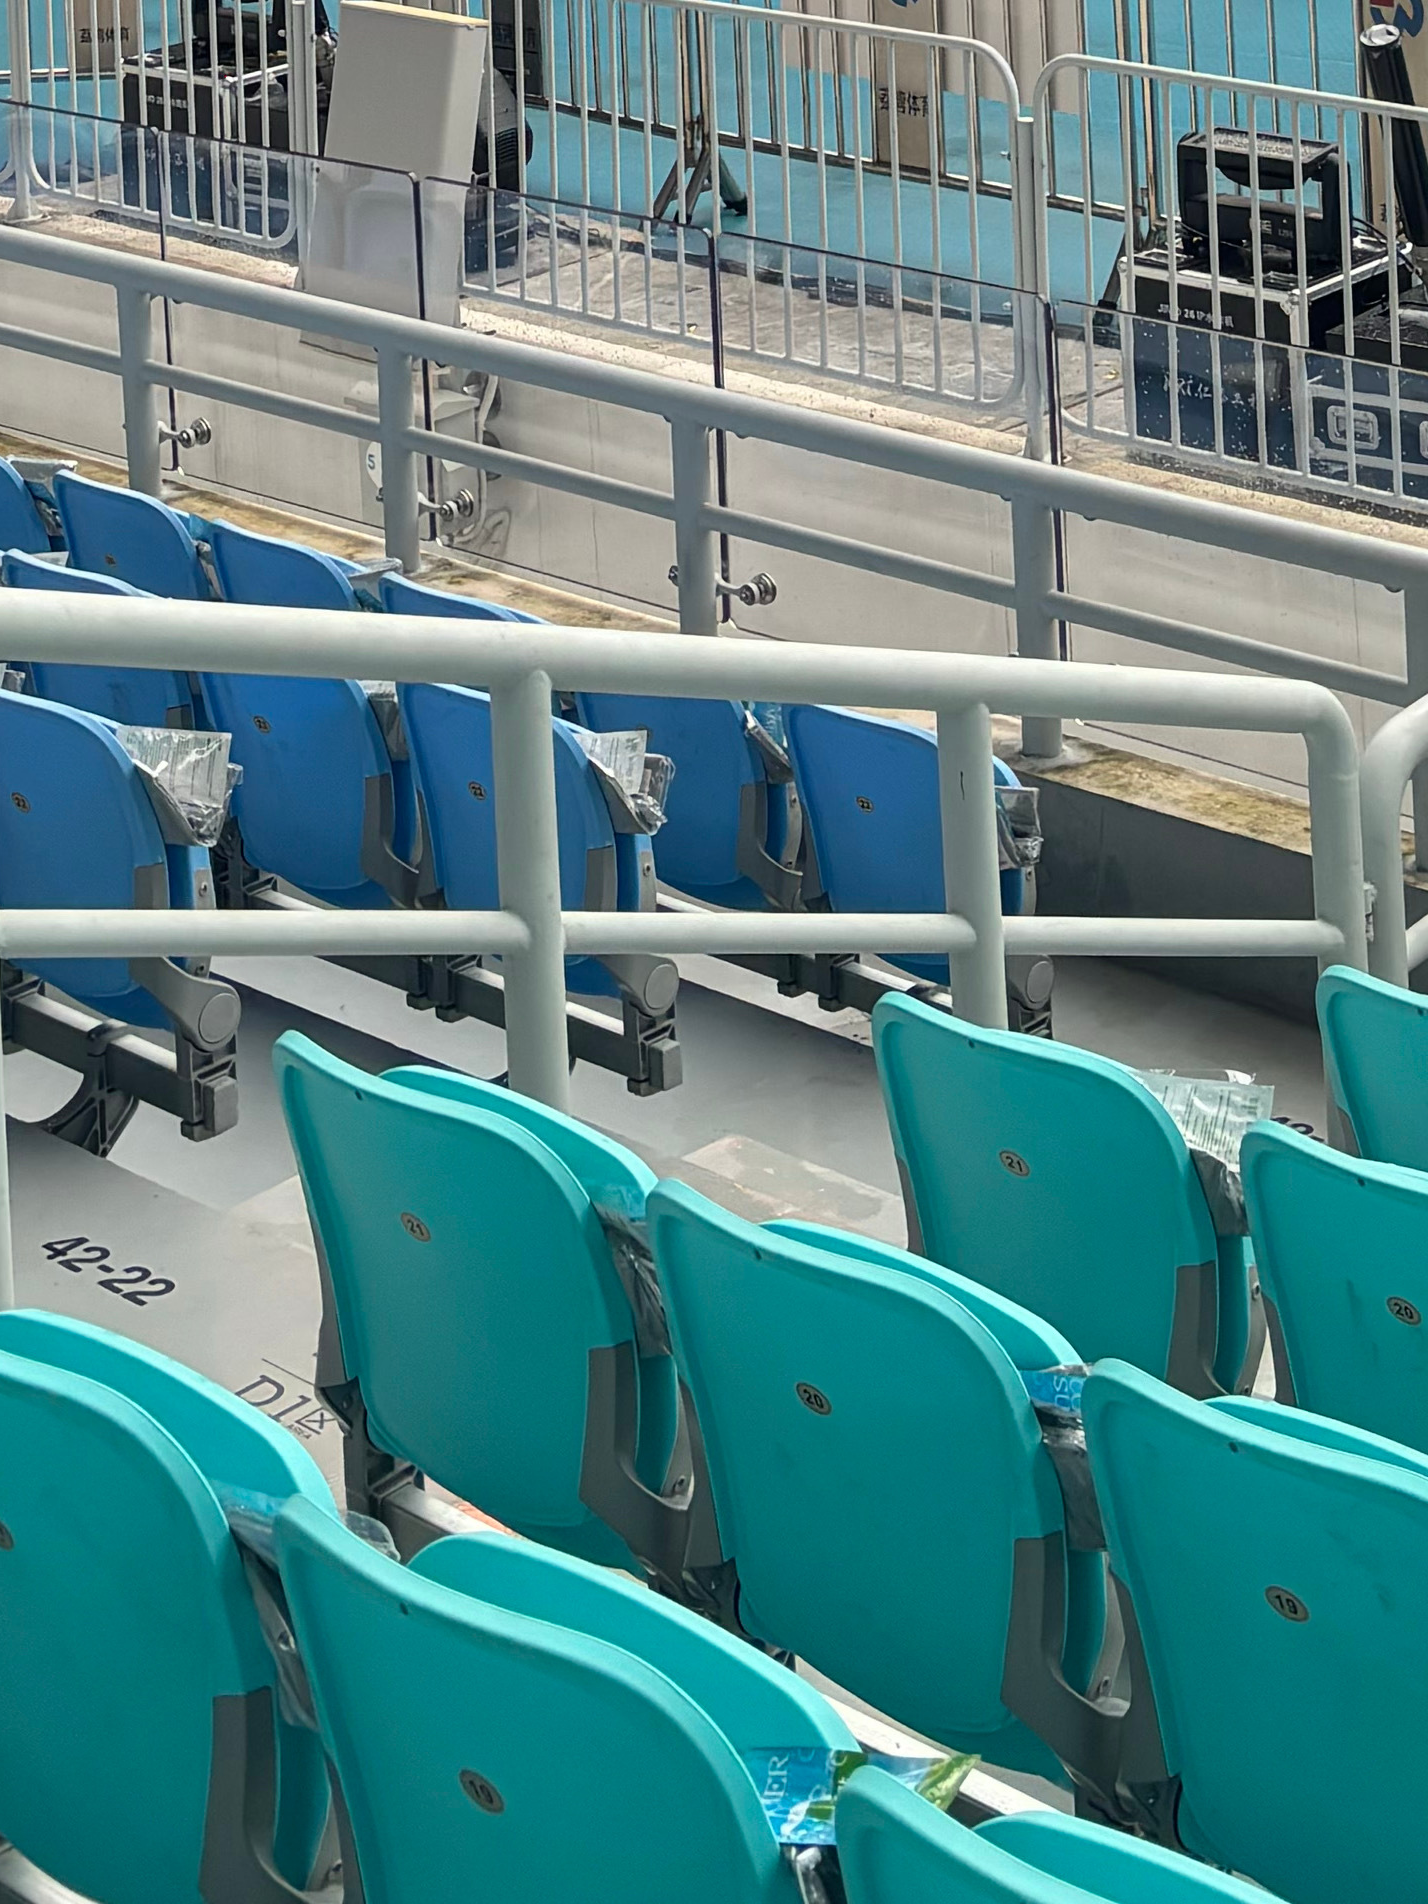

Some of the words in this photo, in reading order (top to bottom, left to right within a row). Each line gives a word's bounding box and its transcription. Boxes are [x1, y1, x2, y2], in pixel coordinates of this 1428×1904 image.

[1005, 1154, 1023, 1173] 21
[406, 1217, 424, 1238] 21
[40, 1234, 178, 1309] 42-22
[1392, 1301, 1414, 1321] 20
[803, 1387, 825, 1410] 20
[1274, 1593, 1299, 1616] 19
